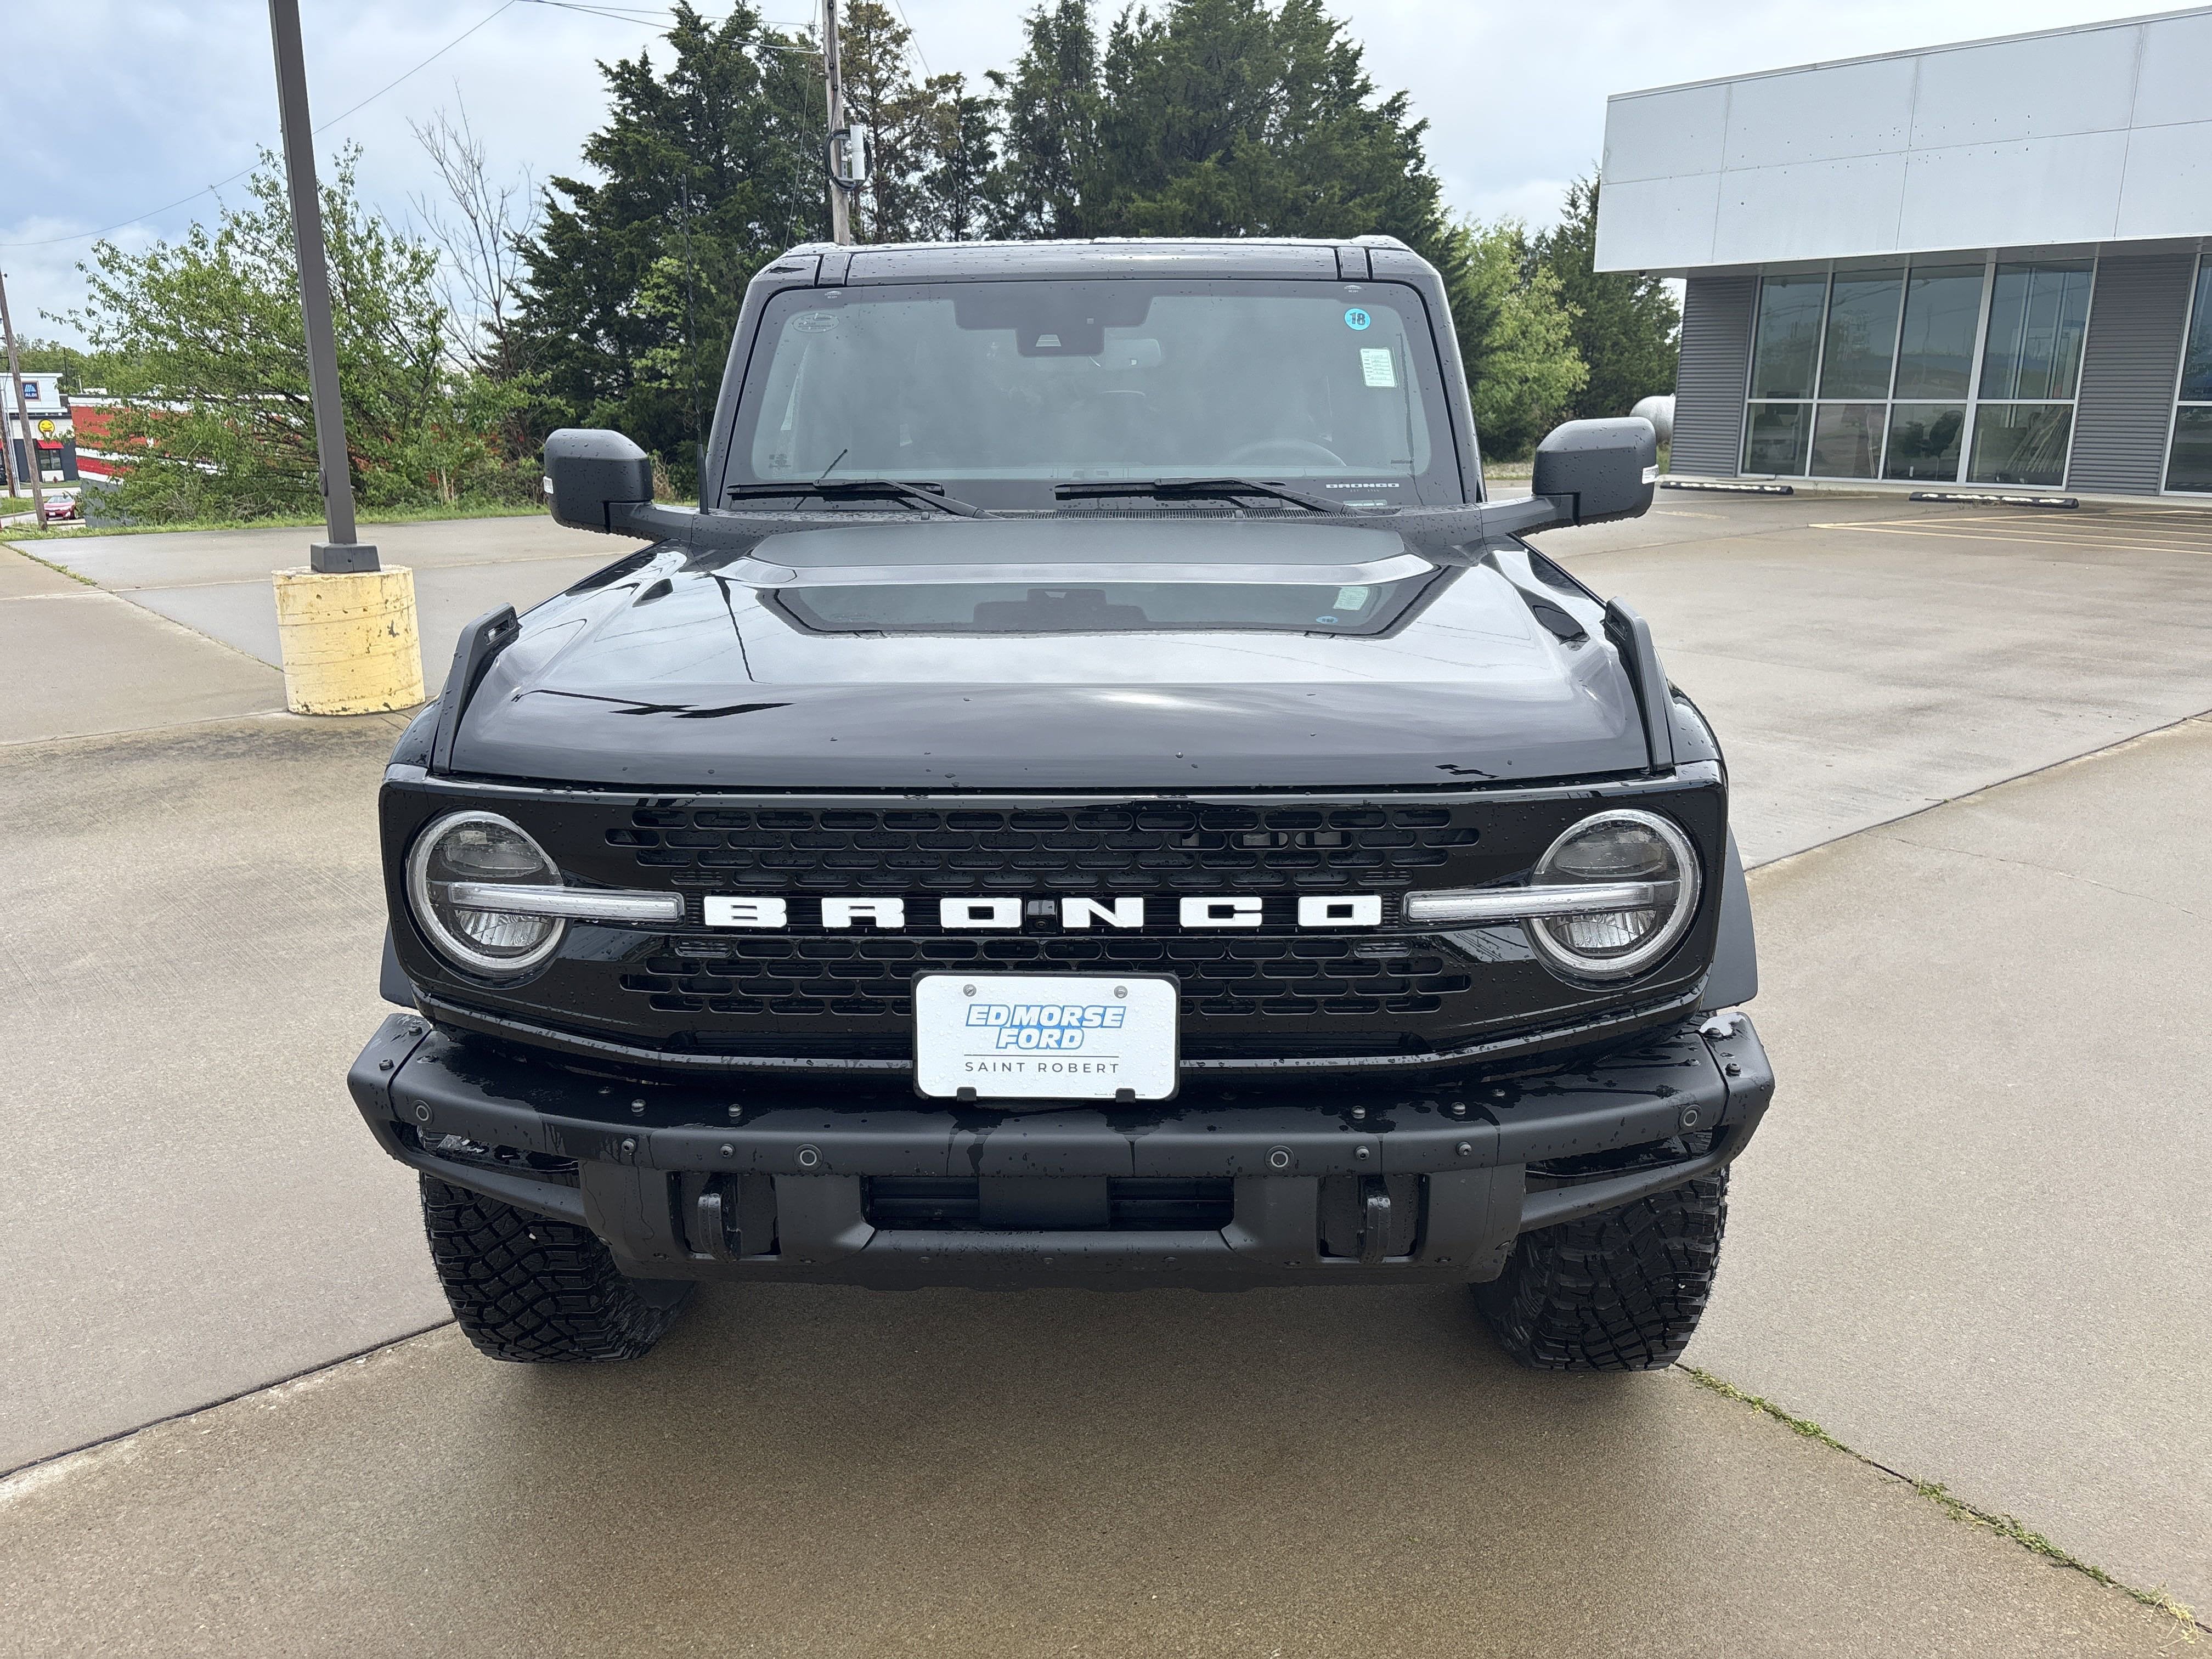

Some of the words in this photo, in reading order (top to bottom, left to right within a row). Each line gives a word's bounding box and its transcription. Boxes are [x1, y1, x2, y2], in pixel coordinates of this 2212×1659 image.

[1349, 312, 1366, 326] 18
[704, 895, 1382, 928] BRONCO
[966, 1004, 1010, 1027] ED
[1009, 1005, 1126, 1028] MORSE
[996, 1026, 1085, 1049] FORD
[965, 1062, 1025, 1073] SAINT
[1037, 1063, 1119, 1074] ROBERT
